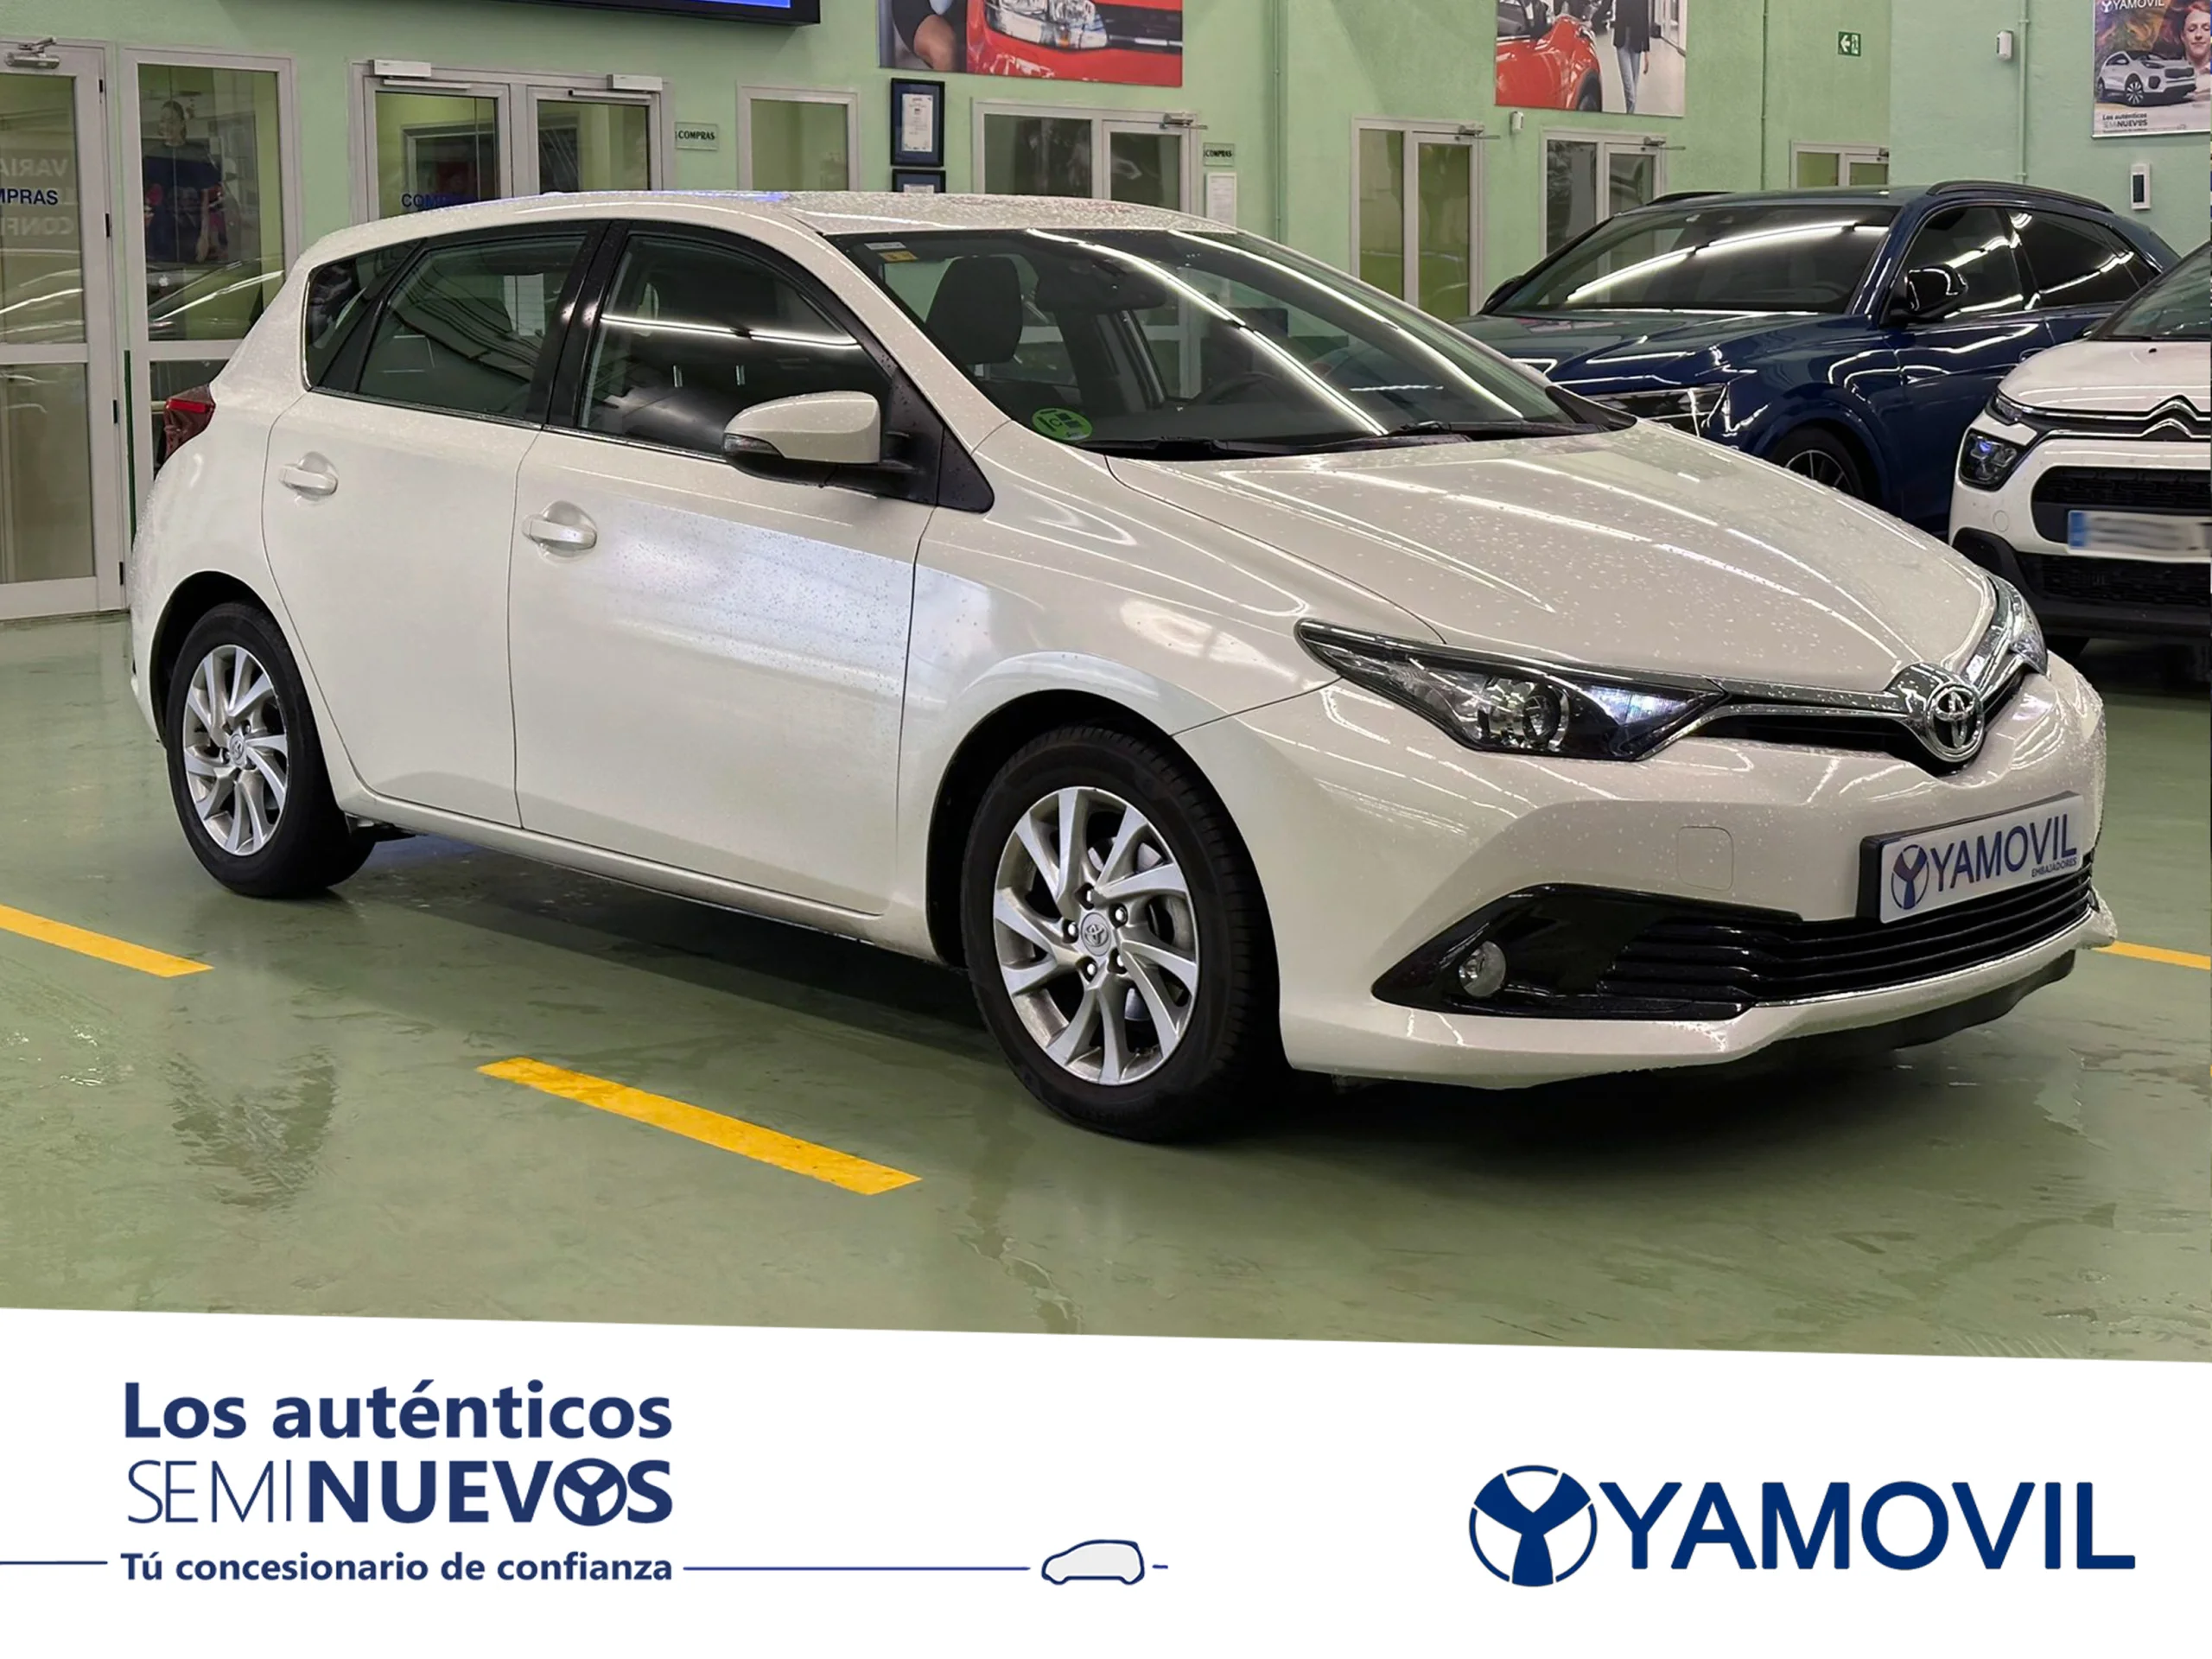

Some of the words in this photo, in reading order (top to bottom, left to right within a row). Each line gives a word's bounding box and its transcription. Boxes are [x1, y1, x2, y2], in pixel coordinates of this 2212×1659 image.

[2112, 0, 2164, 10] YAMOVIL
[678, 130, 715, 141] COMPRAS
[1930, 814, 2078, 893] YAMOVIL
